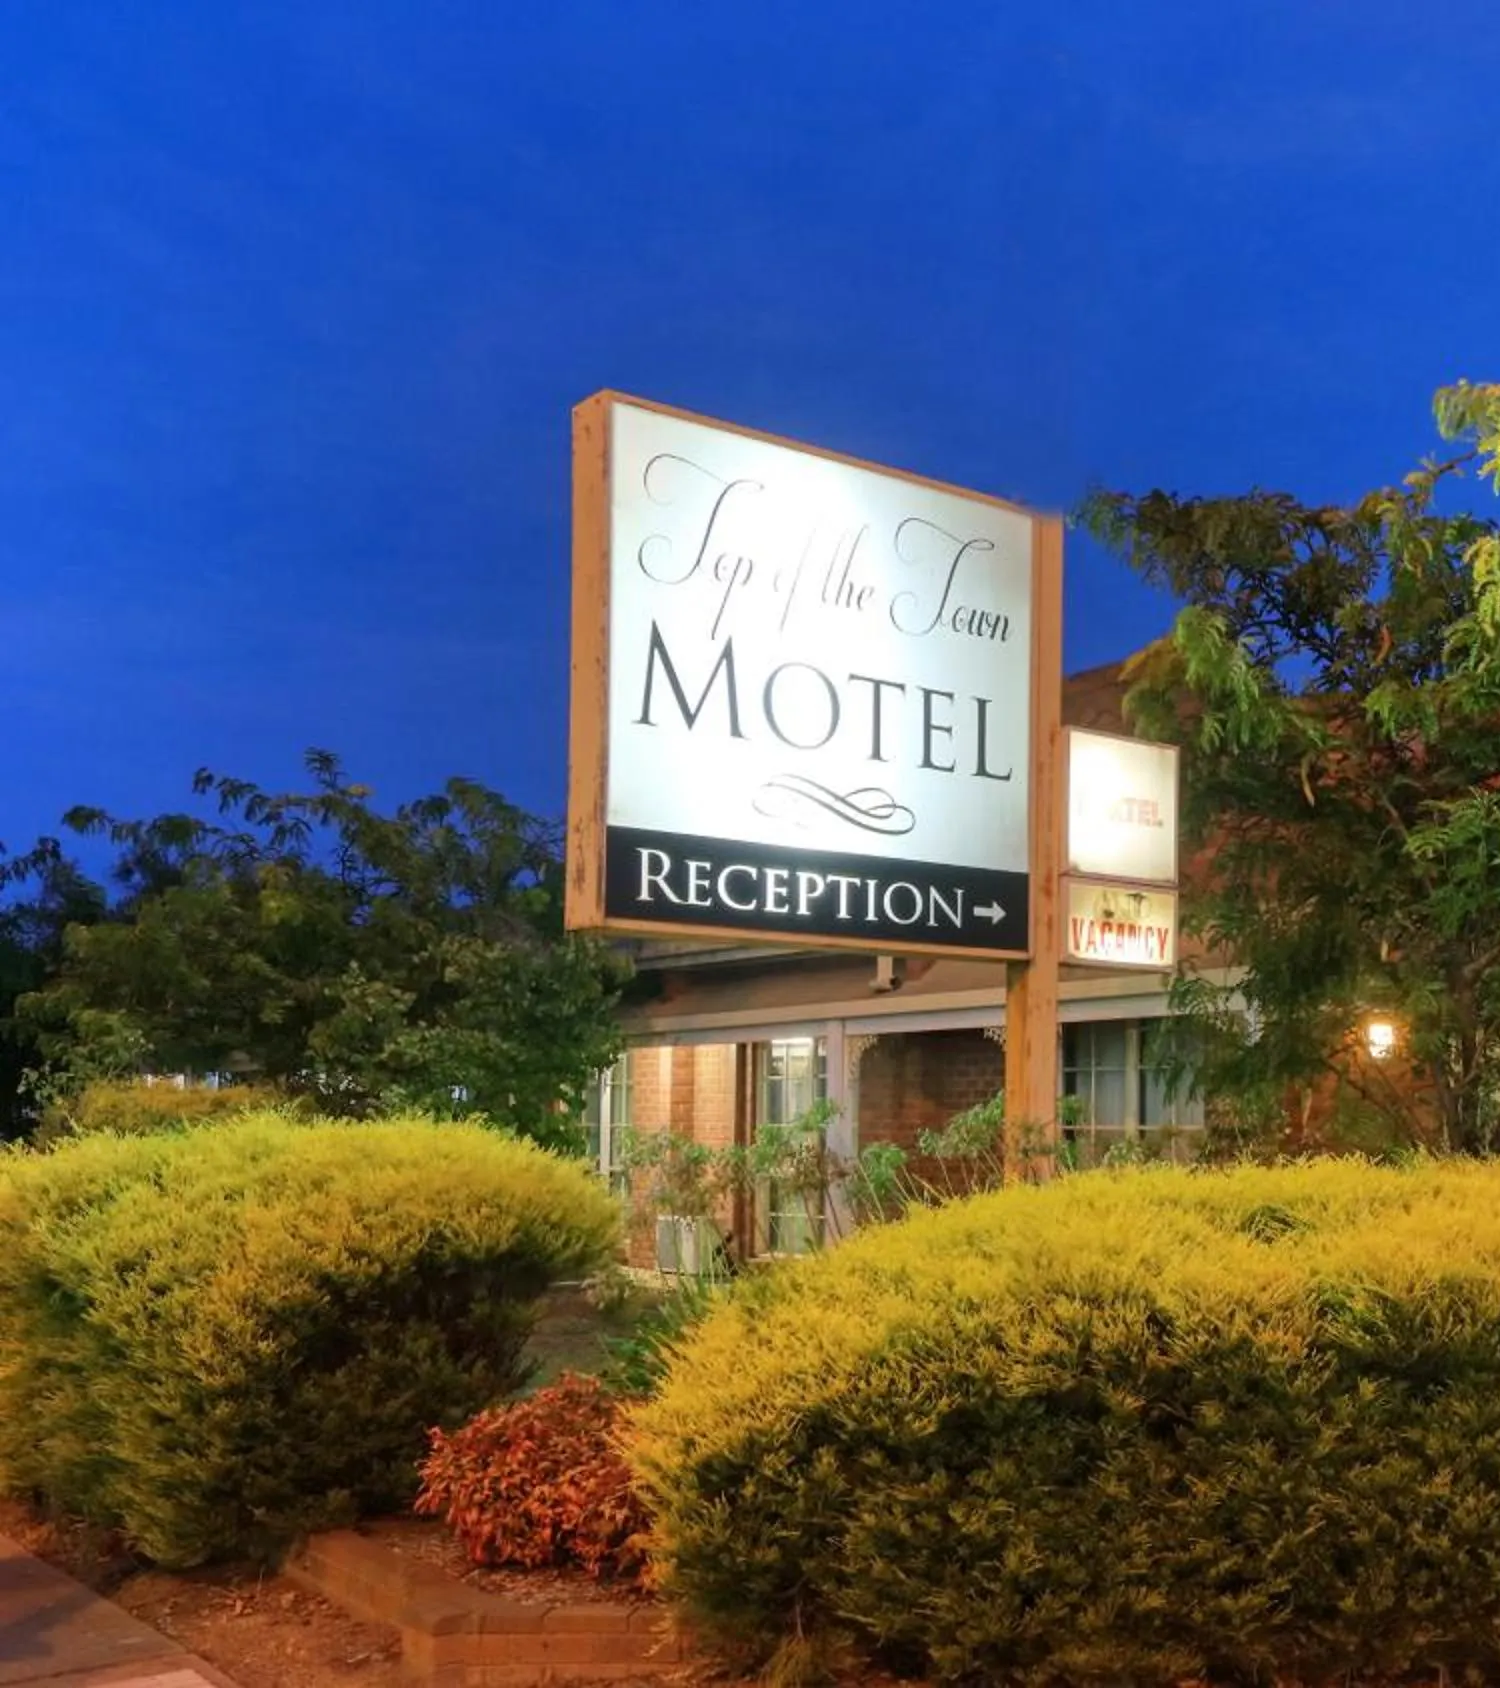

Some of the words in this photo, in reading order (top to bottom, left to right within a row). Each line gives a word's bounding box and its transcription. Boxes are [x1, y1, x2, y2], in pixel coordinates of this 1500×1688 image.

[638, 453, 765, 640] Top
[772, 514, 826, 633] of
[821, 523, 876, 613] the
[889, 516, 1012, 643] Town
[632, 619, 1014, 783] MOTEL
[634, 846, 965, 930] RECEPTION
[1071, 916, 1169, 962] VACANCY
